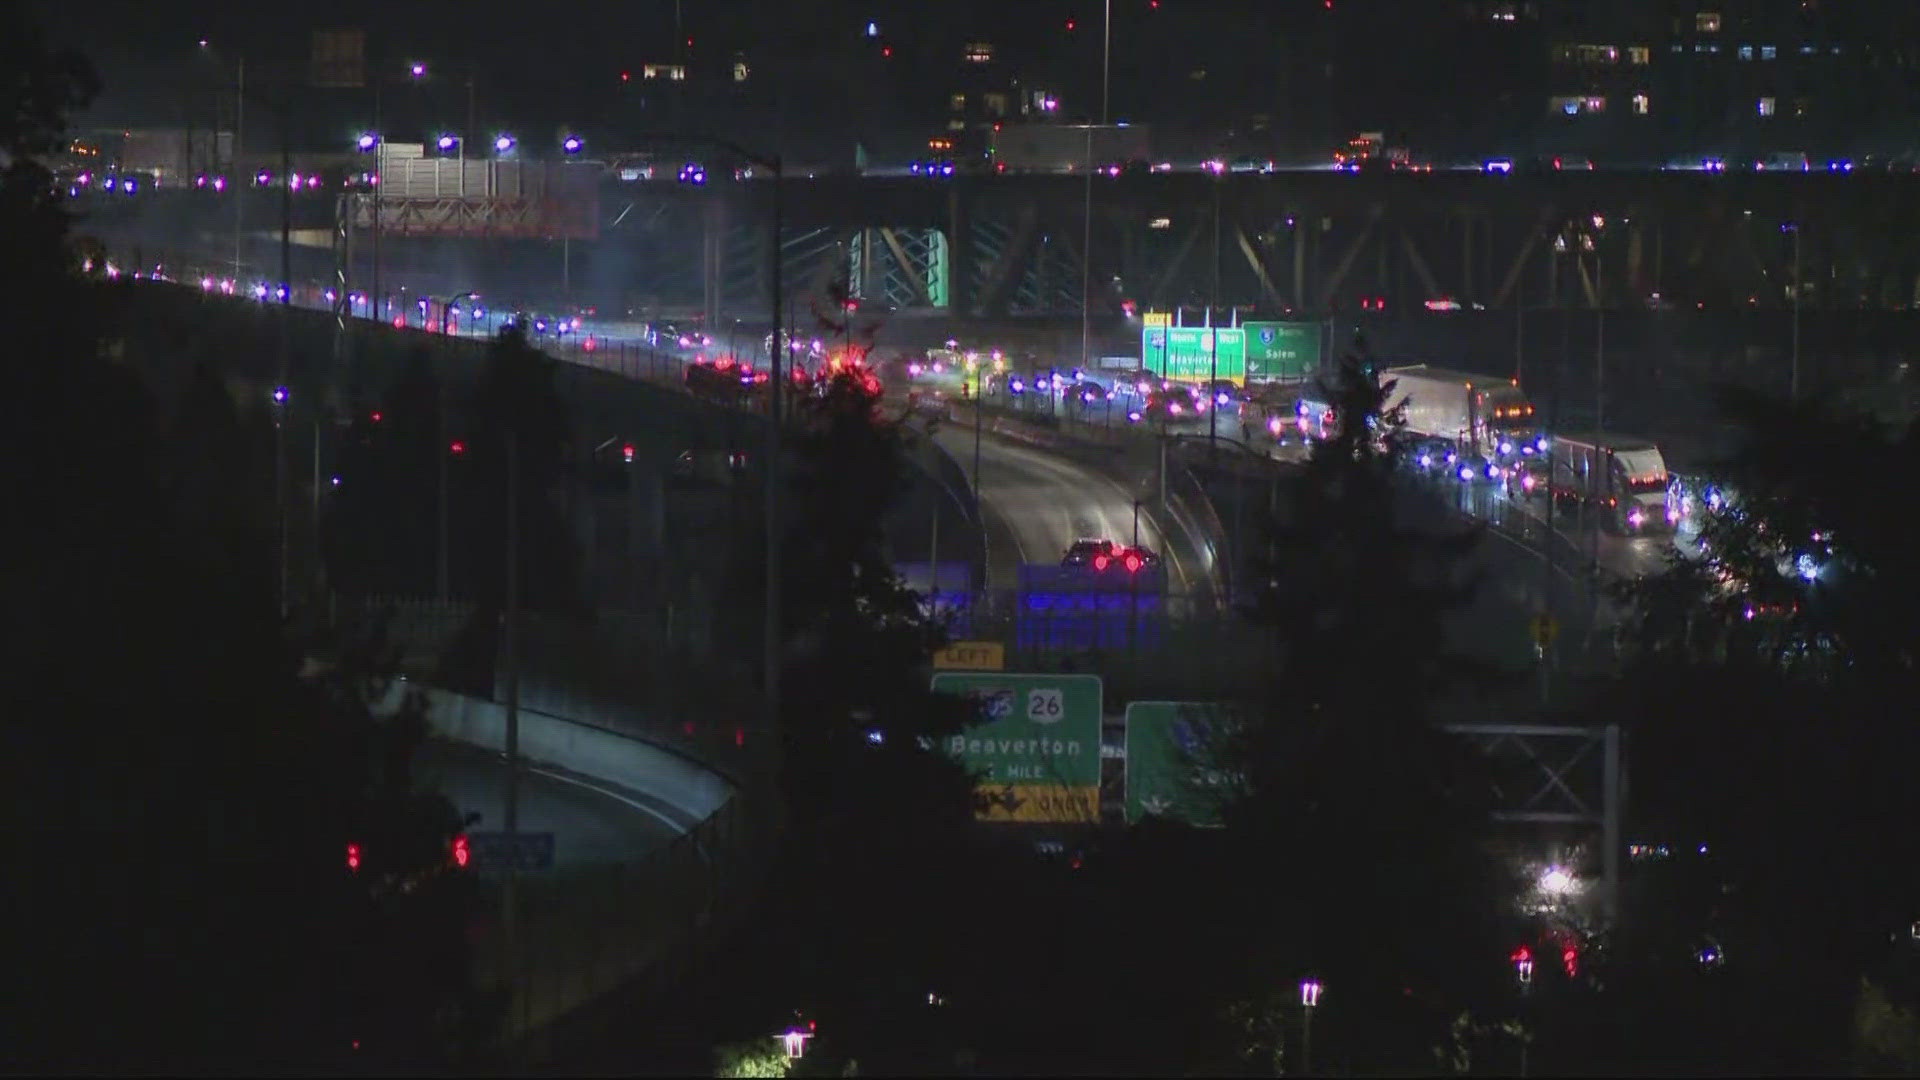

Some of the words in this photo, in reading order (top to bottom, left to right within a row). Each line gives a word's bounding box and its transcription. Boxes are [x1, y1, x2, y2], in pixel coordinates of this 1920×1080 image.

[1265, 349, 1296, 359] Salem
[945, 648, 991, 666] LEFT
[1031, 695, 1060, 716] 26
[950, 734, 1082, 756] Beaverton
[1007, 764, 1043, 778] MILE
